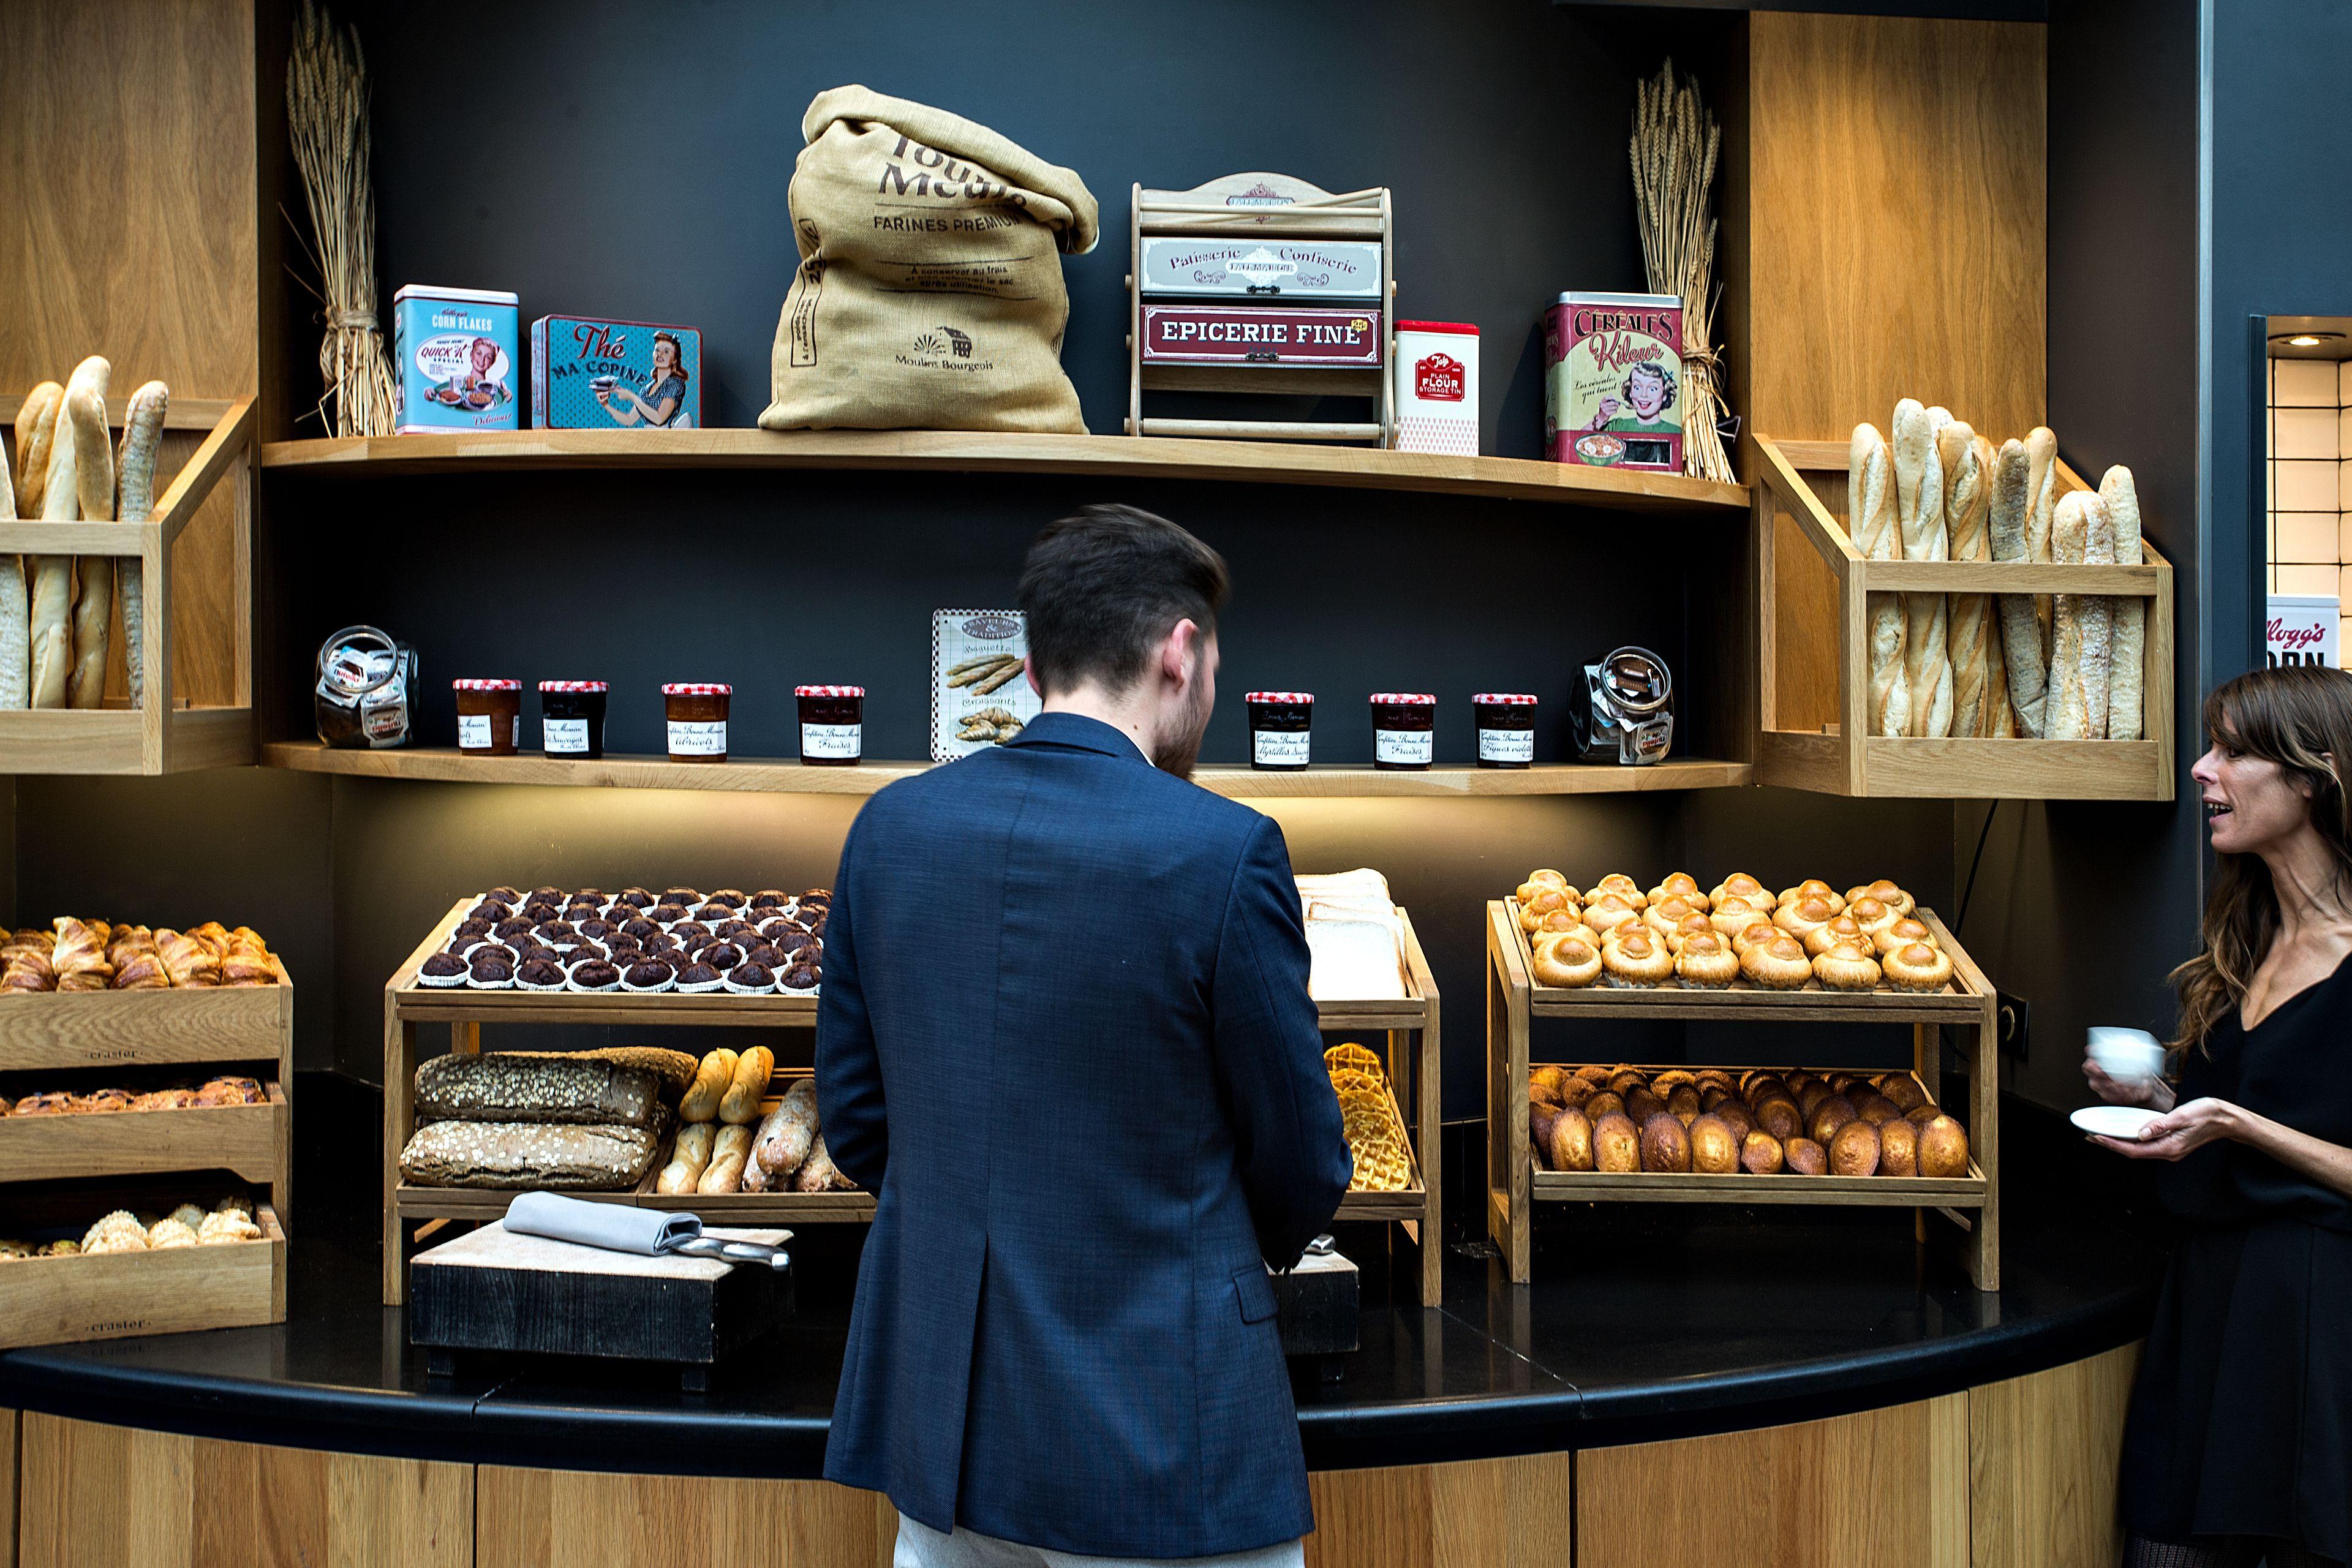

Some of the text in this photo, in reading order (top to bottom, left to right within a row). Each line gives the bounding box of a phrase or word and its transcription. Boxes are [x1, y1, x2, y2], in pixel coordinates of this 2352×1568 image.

[874, 216, 948, 232] FARINES
[1280, 246, 1357, 275] Confiserie
[987, 265, 1008, 274] frais
[432, 314, 492, 331] CORN FLAKES
[1574, 309, 1673, 341] CÉRÉALES
[1161, 321, 1360, 345] EPICERIE FINE
[573, 323, 626, 360] Thé
[421, 347, 453, 358] QUICK
[1589, 328, 1664, 373] Kileur
[942, 360, 993, 372] Bourgeois
[552, 359, 648, 386] MA COPINE
[1422, 377, 1458, 388] FLOUR
[1573, 373, 1616, 391] Les céréales
[1582, 387, 1595, 404] qui
[472, 412, 512, 427] Delicious!
[968, 618, 1015, 628] SAVEURS
[986, 624, 998, 633] &
[967, 627, 1018, 639] TRADITION
[2267, 617, 2326, 649] logg's
[334, 668, 360, 684] nutella
[962, 696, 1017, 707] Croissants
[371, 721, 401, 733] nutella
[676, 736, 712, 745] Abricots
[819, 739, 851, 749] Fraises
[1642, 736, 1665, 748] nutella
[1259, 746, 1289, 758] Myrtilles
[1392, 744, 1422, 755] Fraises
[1483, 742, 1509, 753] Figues
